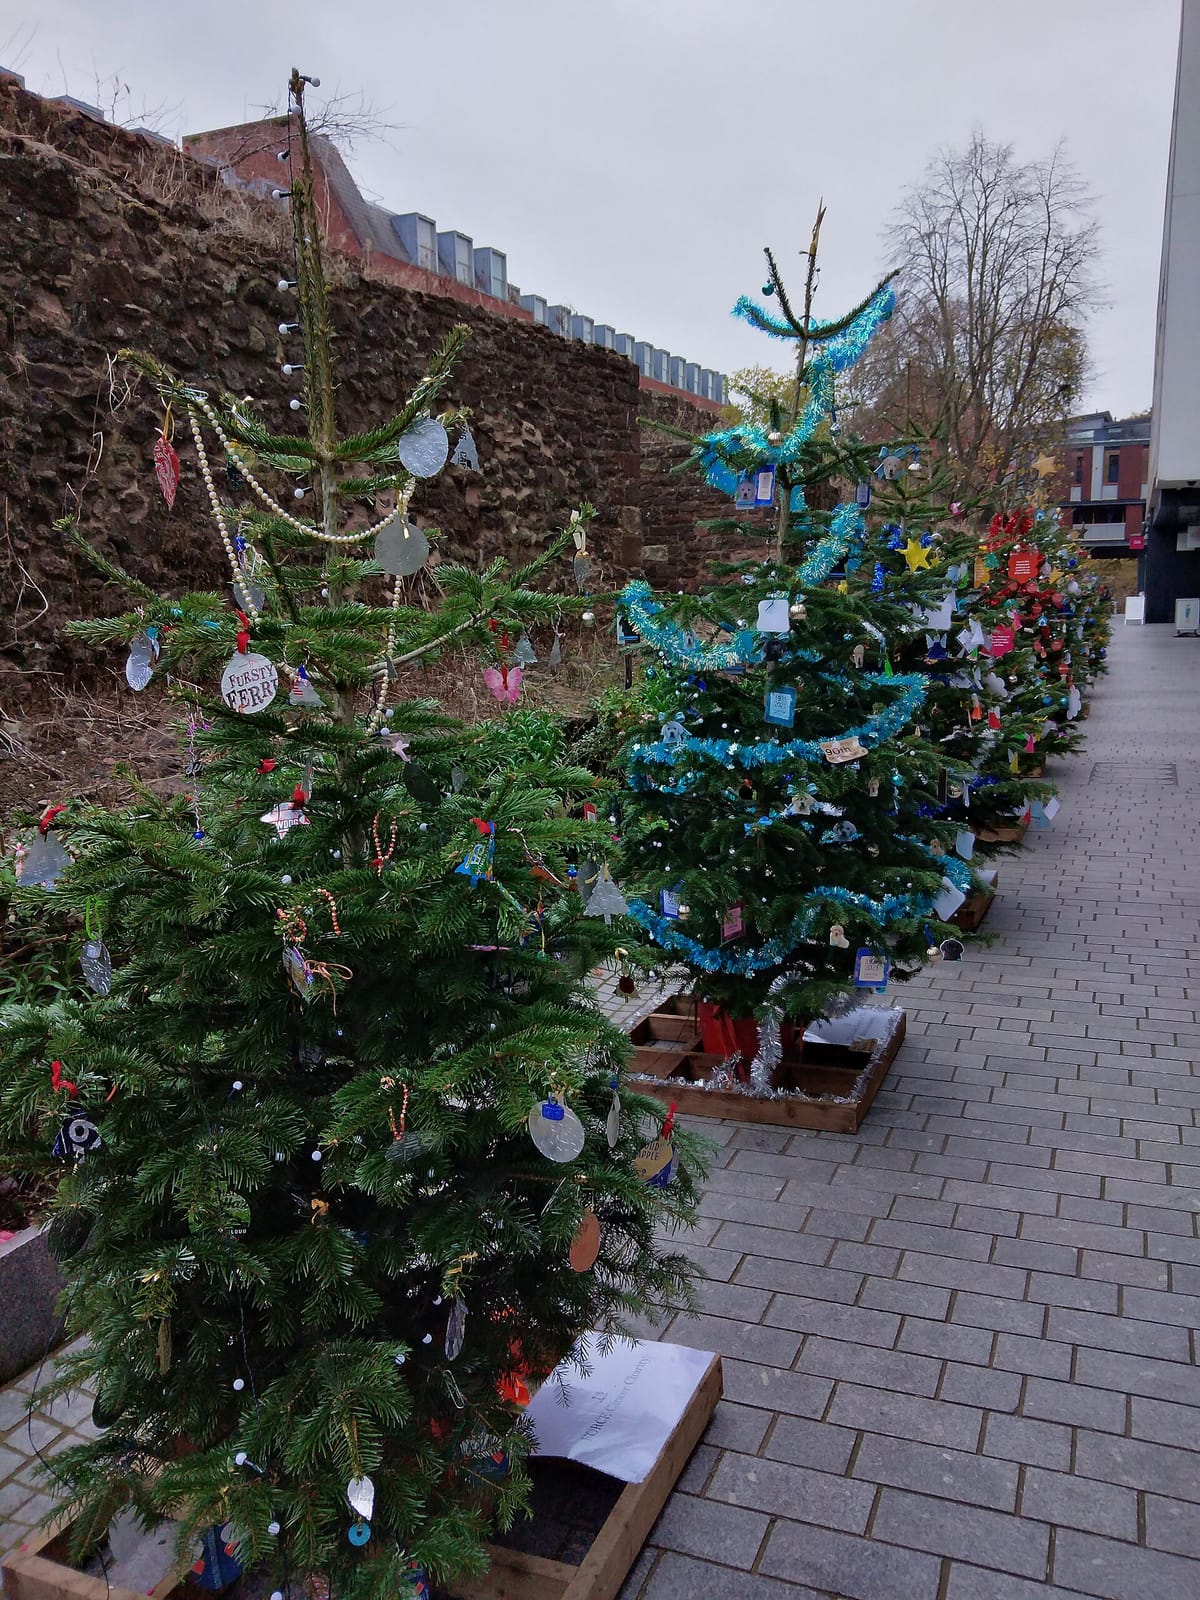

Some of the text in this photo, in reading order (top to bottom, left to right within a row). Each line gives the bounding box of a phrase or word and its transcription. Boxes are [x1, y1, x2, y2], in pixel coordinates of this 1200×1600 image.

[228, 664, 274, 689] FURSTY
[825, 745, 852, 756] 90th
[581, 1412, 613, 1442] FORCE
